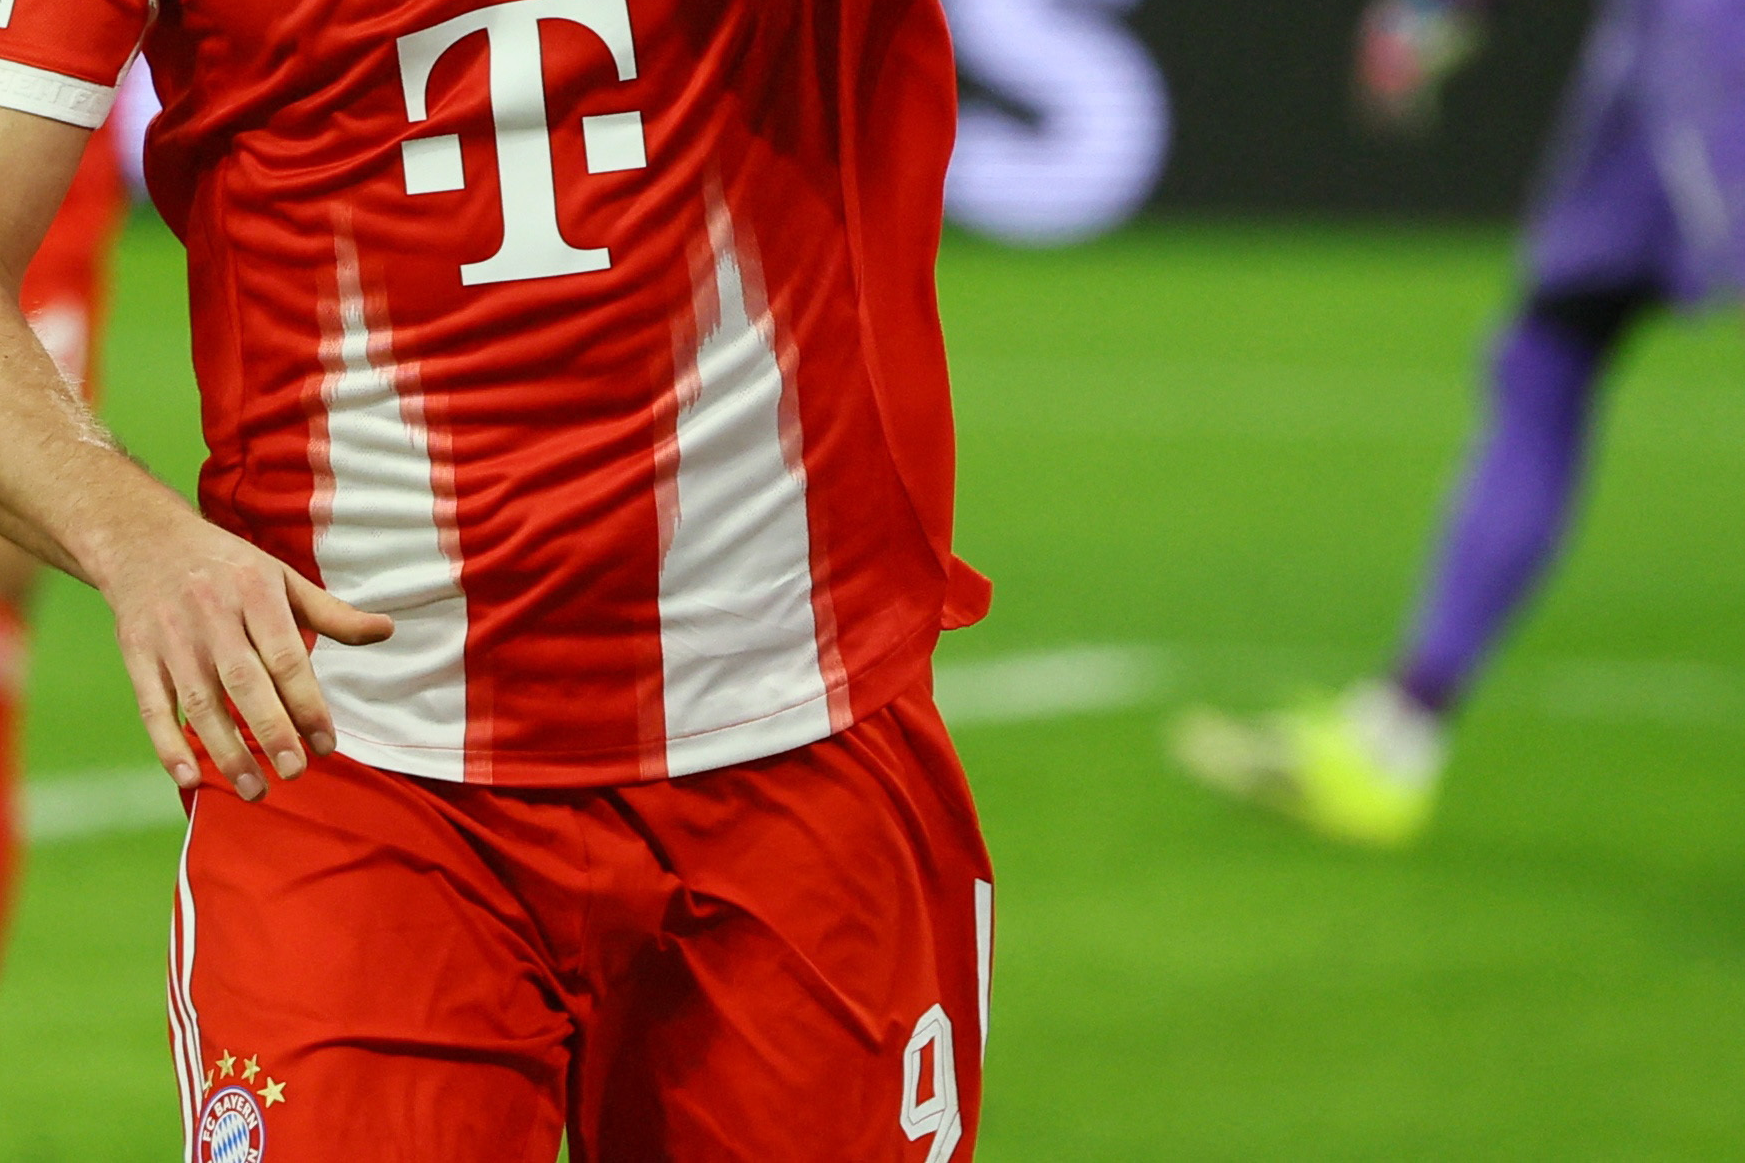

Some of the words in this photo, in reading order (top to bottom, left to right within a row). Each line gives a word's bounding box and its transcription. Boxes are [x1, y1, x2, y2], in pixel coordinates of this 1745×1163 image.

[202, 1117, 216, 1142] FC
[214, 1094, 259, 1130] BAYERN
[900, 1002, 962, 1163] 9
